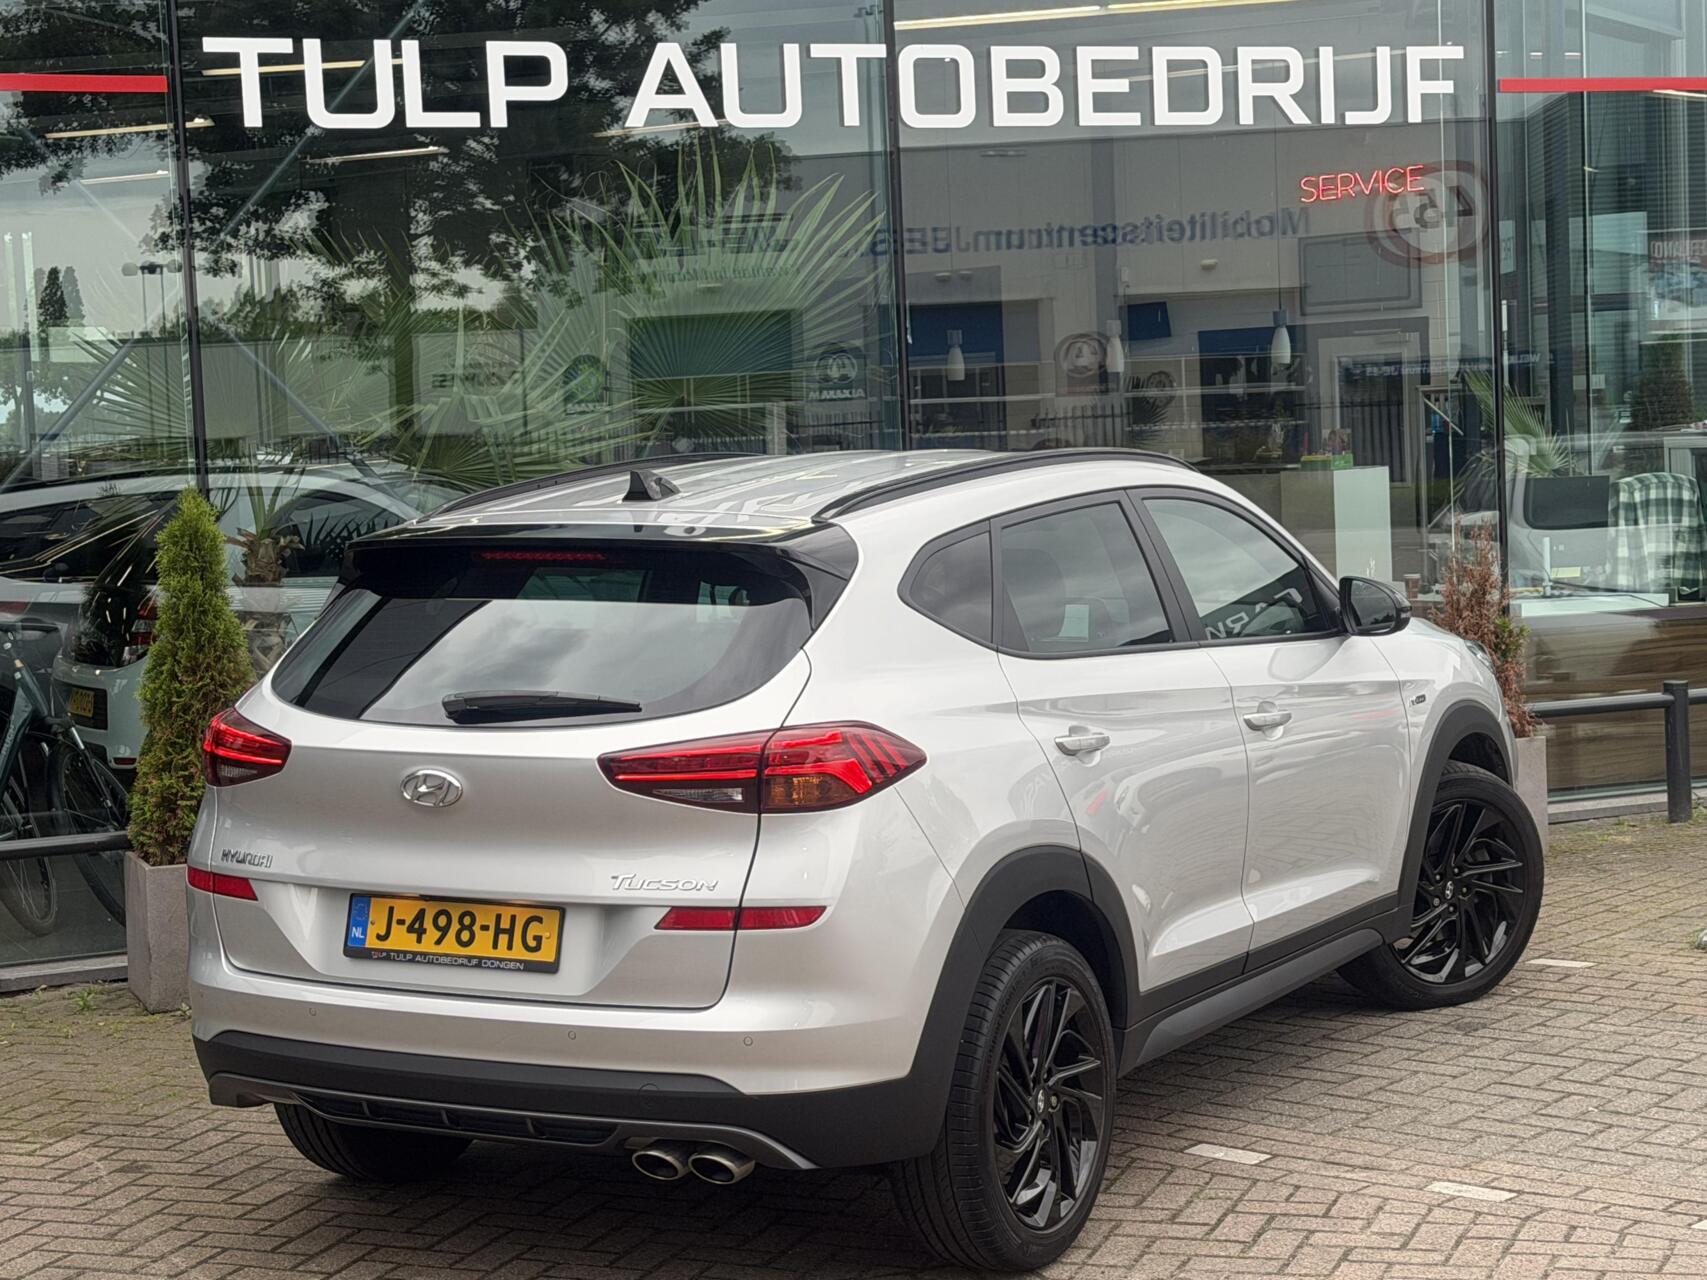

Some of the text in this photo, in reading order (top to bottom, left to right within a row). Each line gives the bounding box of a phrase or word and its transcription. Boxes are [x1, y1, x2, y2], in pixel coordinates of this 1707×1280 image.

[202, 37, 1465, 129] TULP AUTOBEDRIJF
[1299, 163, 1426, 204] SERVICE
[351, 926, 366, 939] NL
[375, 905, 544, 954] J-498-HG
[389, 952, 413, 962] TULP
[415, 954, 478, 967] AUTOBEDRIJF
[481, 959, 525, 971] DONGEN
